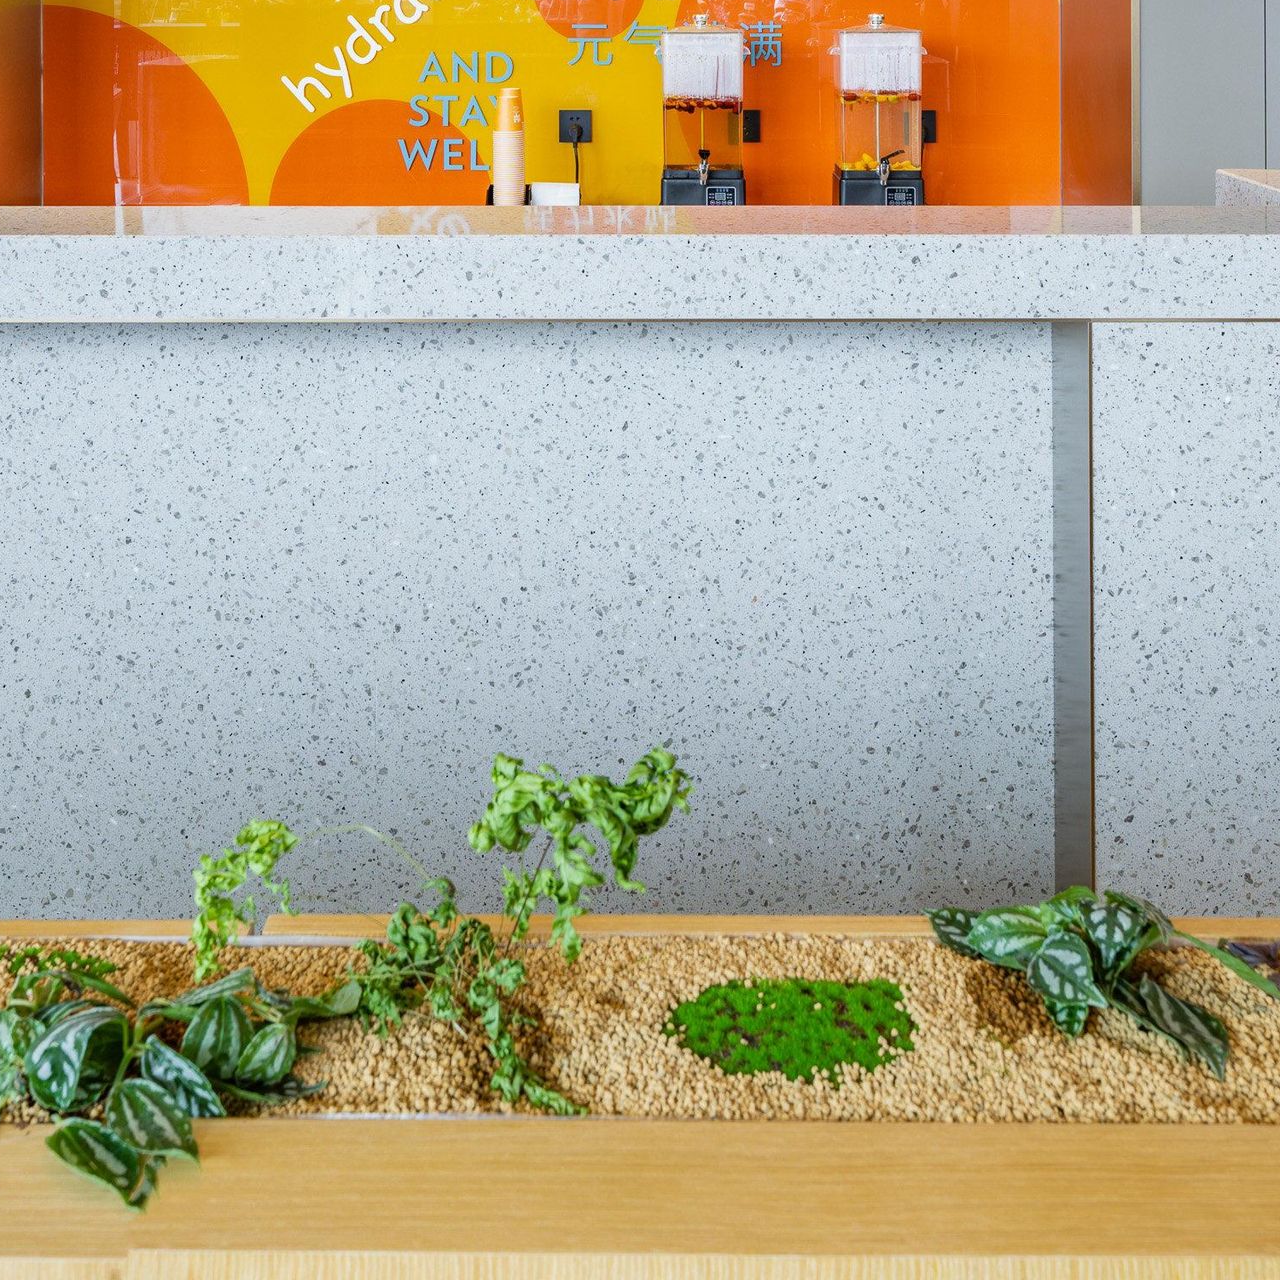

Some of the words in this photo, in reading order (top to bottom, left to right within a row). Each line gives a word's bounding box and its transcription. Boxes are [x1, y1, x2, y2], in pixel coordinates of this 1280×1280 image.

[567, 20, 783, 67] 元气满
[419, 51, 514, 84] AND
[410, 95, 498, 128] STA
[399, 138, 491, 172] WEL
